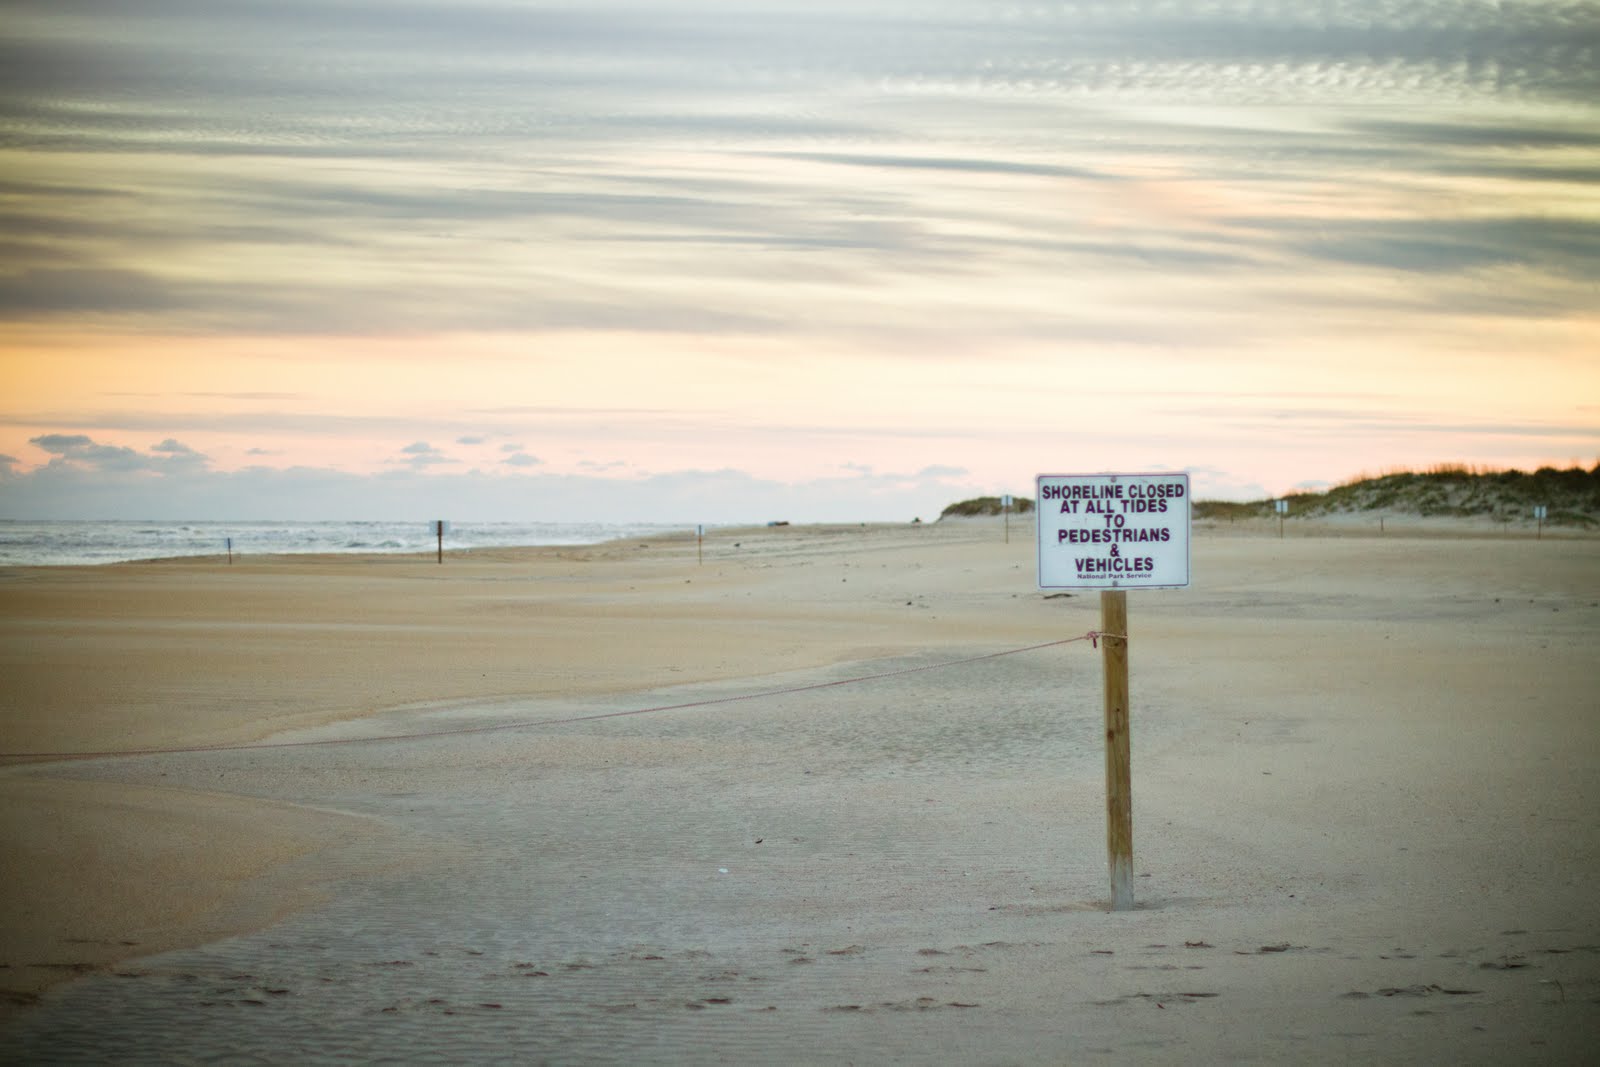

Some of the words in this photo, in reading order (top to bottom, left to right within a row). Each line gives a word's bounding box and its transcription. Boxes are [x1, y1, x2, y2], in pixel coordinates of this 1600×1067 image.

[1042, 485, 1123, 499] SHORELINE
[1129, 484, 1184, 498] CLOSED
[1060, 500, 1080, 513] AT
[1085, 500, 1114, 513] ALL
[1121, 498, 1168, 512] TIDES
[1104, 514, 1126, 528] TO
[1058, 528, 1171, 543] PEDESTRIANS
[1110, 543, 1121, 557] &
[1075, 557, 1154, 572] VEHICLES
